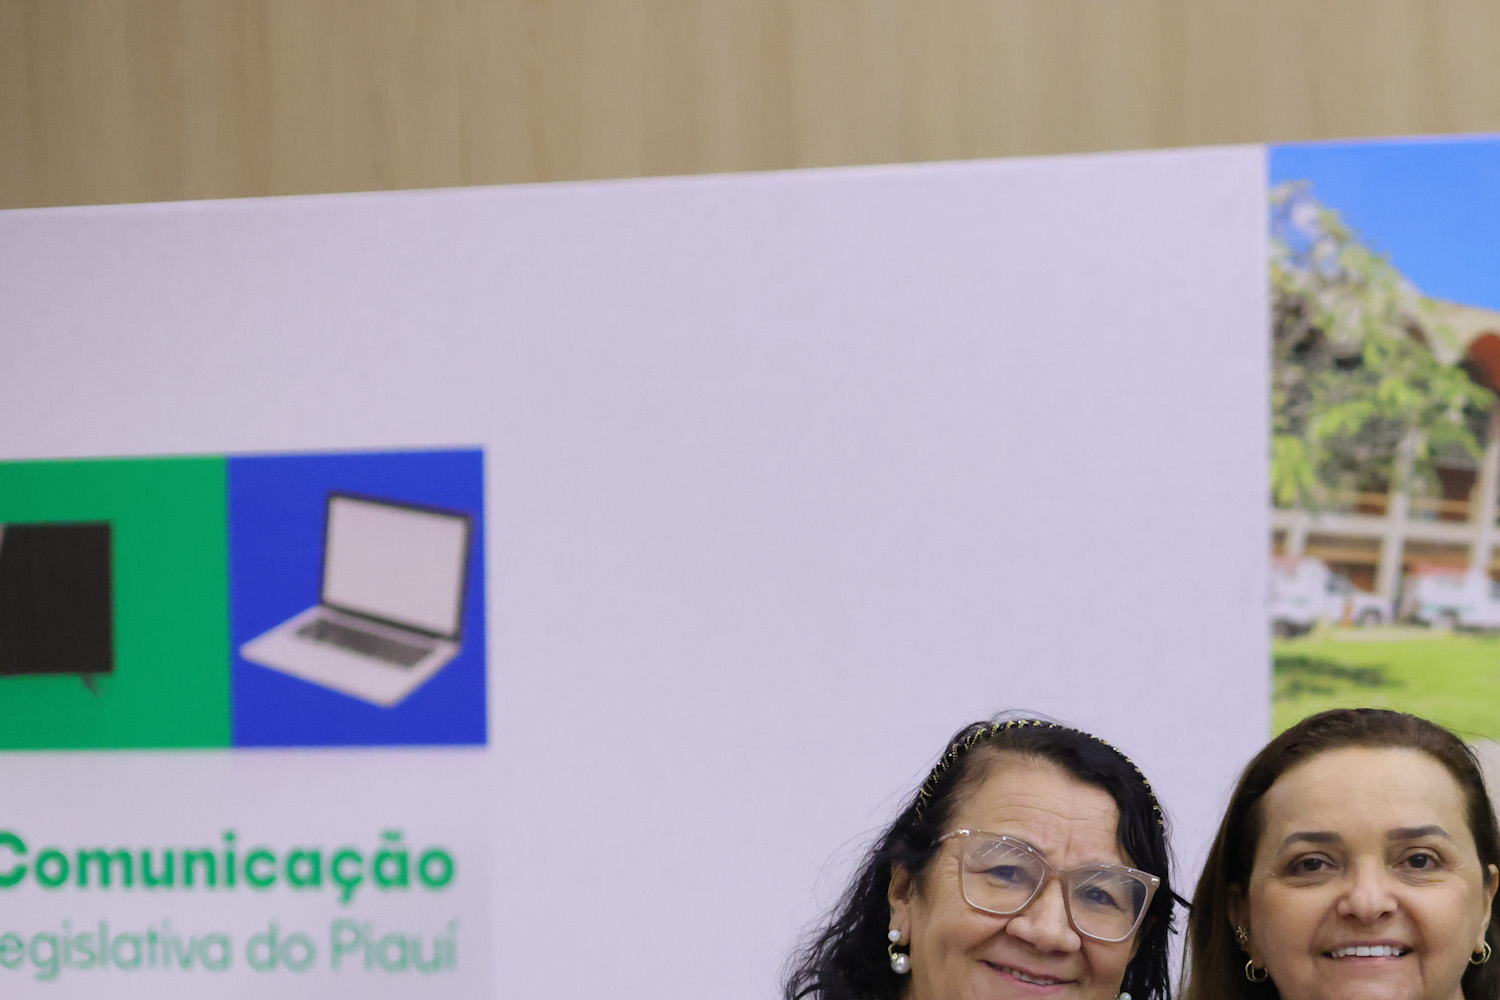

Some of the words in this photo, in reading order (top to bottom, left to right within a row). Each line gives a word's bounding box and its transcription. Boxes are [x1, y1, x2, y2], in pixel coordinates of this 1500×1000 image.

[0, 828, 456, 905] Comunicação
[246, 919, 316, 972] do
[330, 915, 459, 973] Piauí
